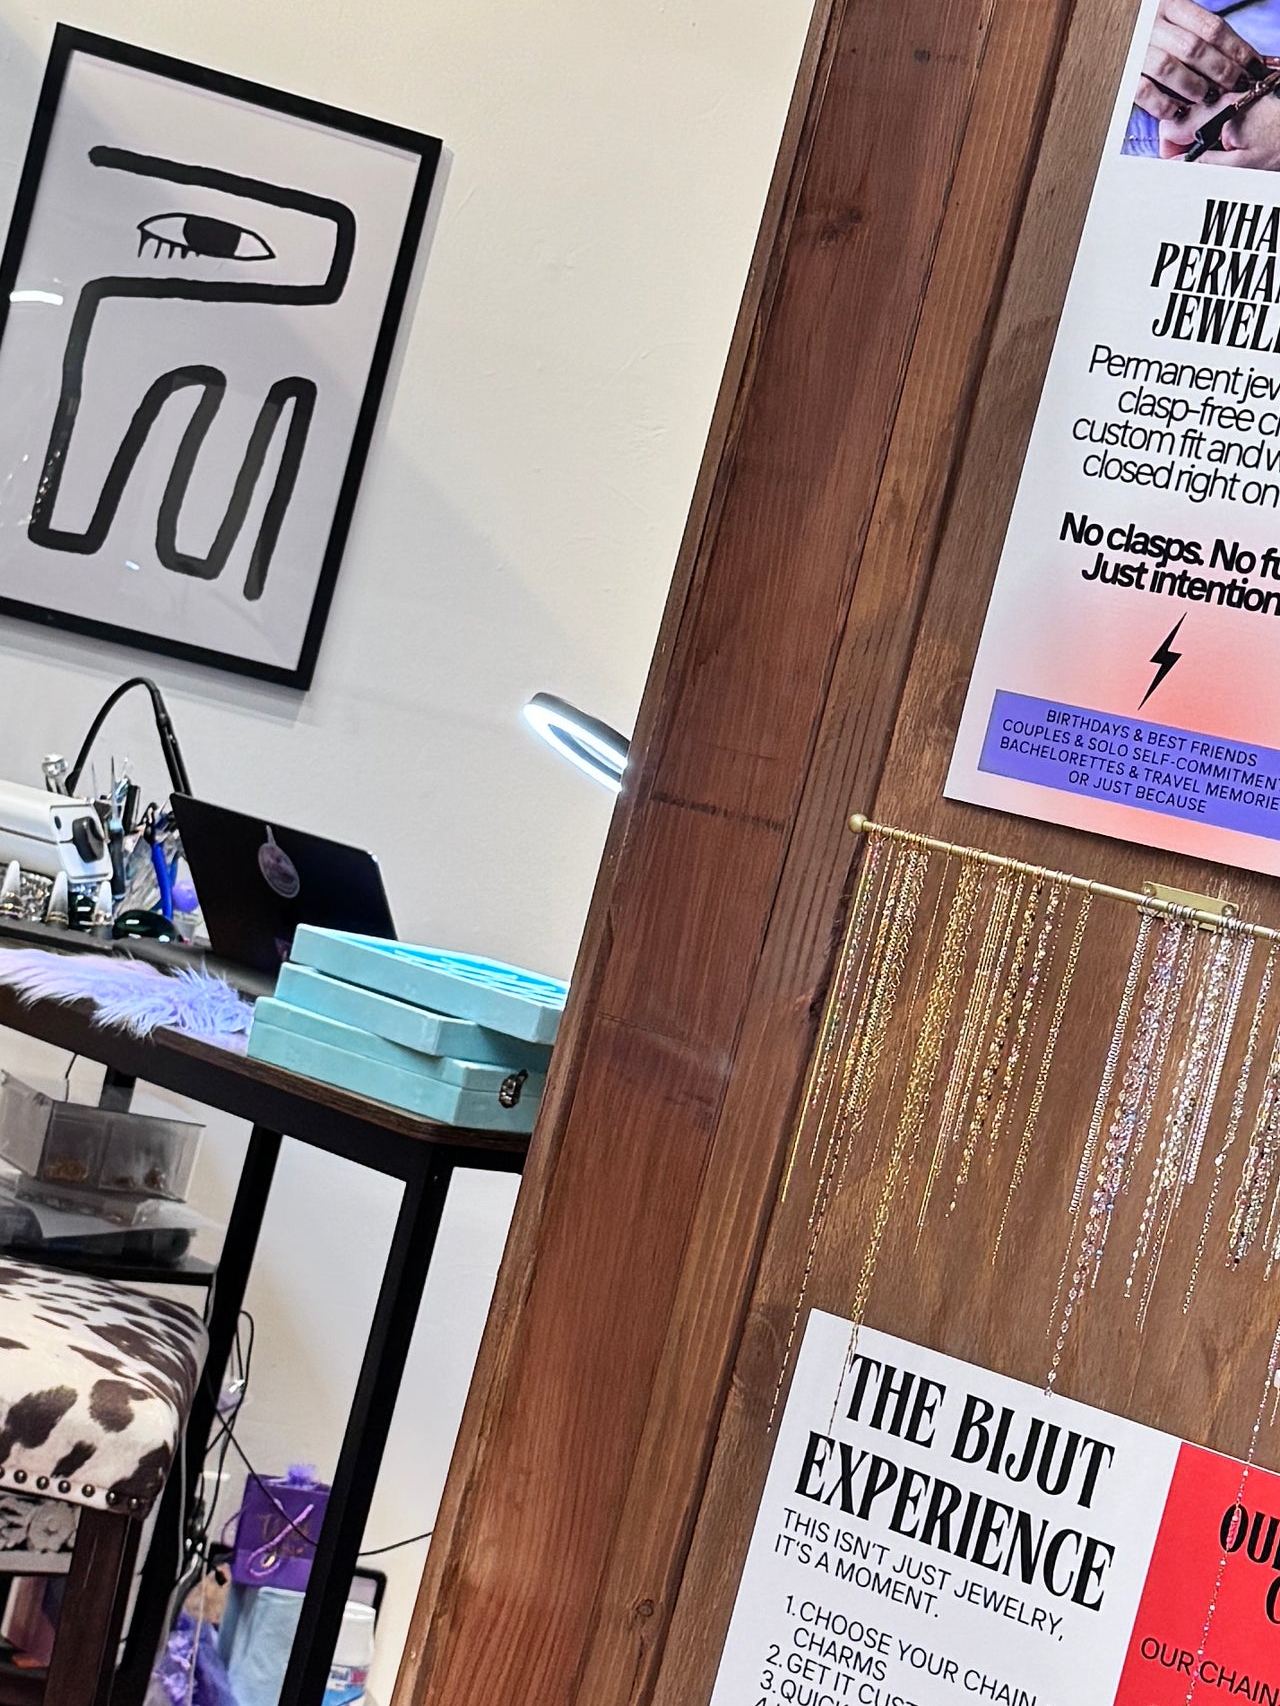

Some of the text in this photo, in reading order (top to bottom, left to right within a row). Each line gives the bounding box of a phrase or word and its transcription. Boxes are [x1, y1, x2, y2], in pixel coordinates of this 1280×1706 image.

[1088, 344, 1244, 396] Permanent
[1117, 385, 1255, 432] clasp-free
[1072, 418, 1176, 456] custom
[1178, 428, 1207, 460] fit
[1206, 439, 1266, 469] and
[1082, 449, 1175, 490] closed
[1174, 467, 1241, 504] right
[1241, 481, 1280, 508] on
[1059, 511, 1104, 547] No
[1106, 523, 1205, 568] clasps.
[1208, 538, 1257, 575] No
[1081, 552, 1150, 590] Just
[999, 735, 1126, 776] BACHELORETTES
[1128, 765, 1140, 780] &
[1143, 767, 1200, 794] TRAVEL
[1002, 718, 1071, 745] COUPLES
[1073, 734, 1084, 748] &
[1087, 736, 1129, 757] SOLO
[1046, 708, 1258, 767] BIRTHDAYS & BEST FRIENDS
[1068, 770, 1207, 814] OR JUST BECAUSE
[846, 1353, 1116, 1509] THE BIJUT
[794, 1430, 1116, 1612] EXPERIENCE
[774, 1533, 939, 1618] IT'S A MOMENT.
[783, 1507, 1063, 1642] THIS ISN'T JUST JEWELRY,
[793, 1627, 887, 1682] CHARMS
[799, 1601, 893, 1656] CHOOSE
[898, 1639, 959, 1684] YOUR
[1139, 1636, 1195, 1678] OUR
[787, 1652, 832, 1685] GET
[833, 1671, 856, 1696] IT
